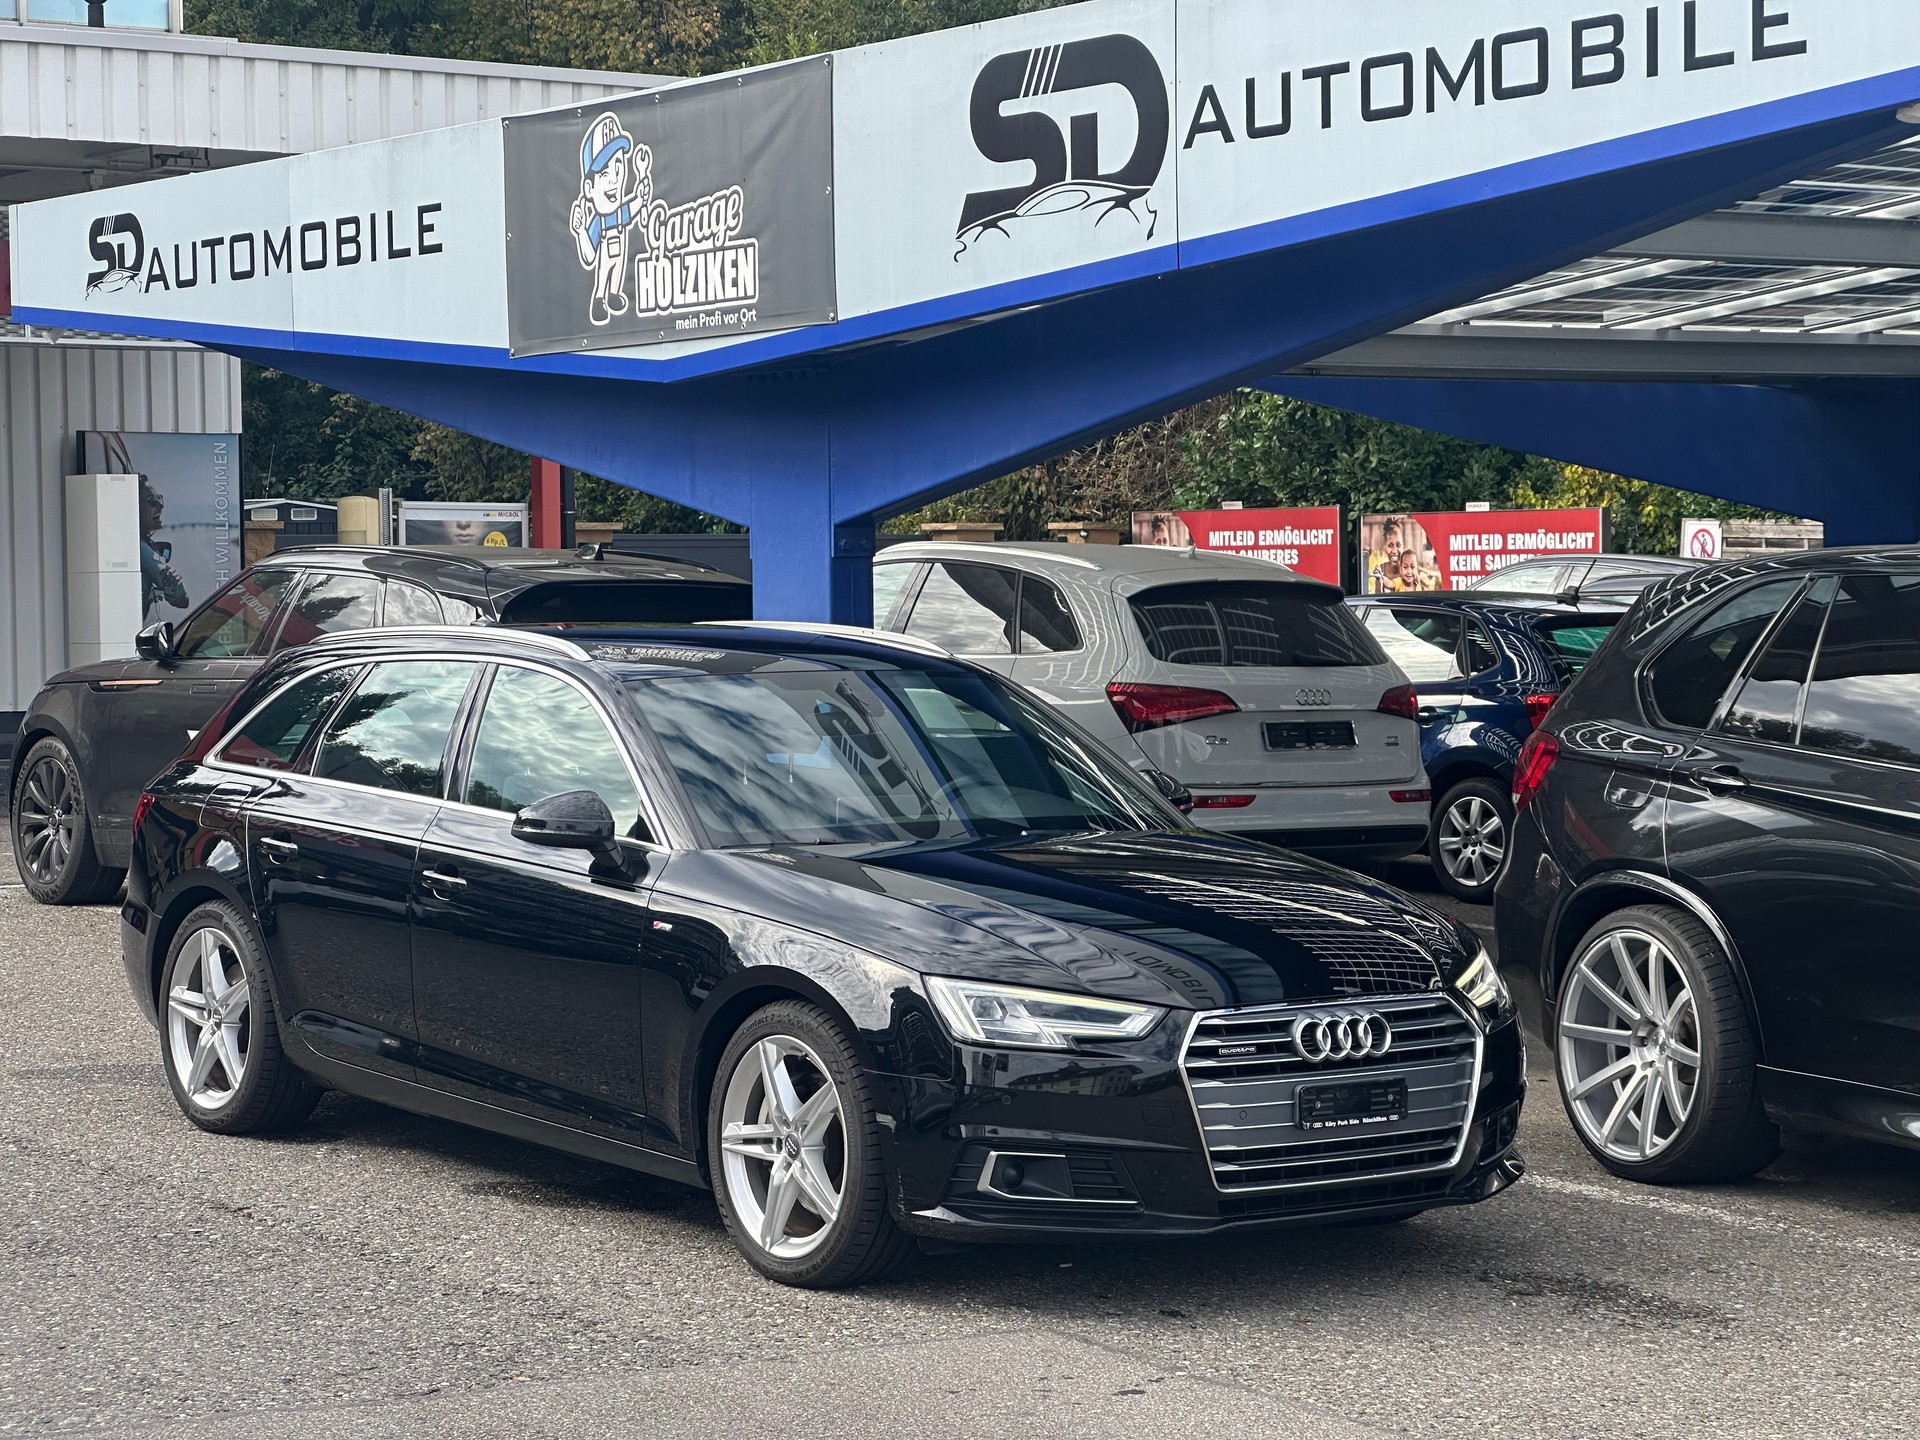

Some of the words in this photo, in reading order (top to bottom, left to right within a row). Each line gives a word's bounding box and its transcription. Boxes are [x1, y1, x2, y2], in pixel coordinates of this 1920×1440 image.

[1183, 0, 1807, 150] AUTOMOBILE
[144, 203, 443, 293] AUTOMOBILE
[648, 193, 740, 266] Garage
[639, 246, 755, 310] HOLZIKEN
[676, 315, 698, 330] mein
[699, 311, 722, 328] Profi
[723, 313, 738, 325] vor
[740, 308, 757, 322] Ort
[213, 442, 230, 564] WILLKOMMEN
[1208, 530, 1255, 547] MITLEID
[1258, 526, 1334, 546] ERMÖGLICHT
[1450, 533, 1503, 551] MITLEID
[1507, 528, 1595, 550] ERMÖGLICHT
[1450, 554, 1481, 571] KEIN
